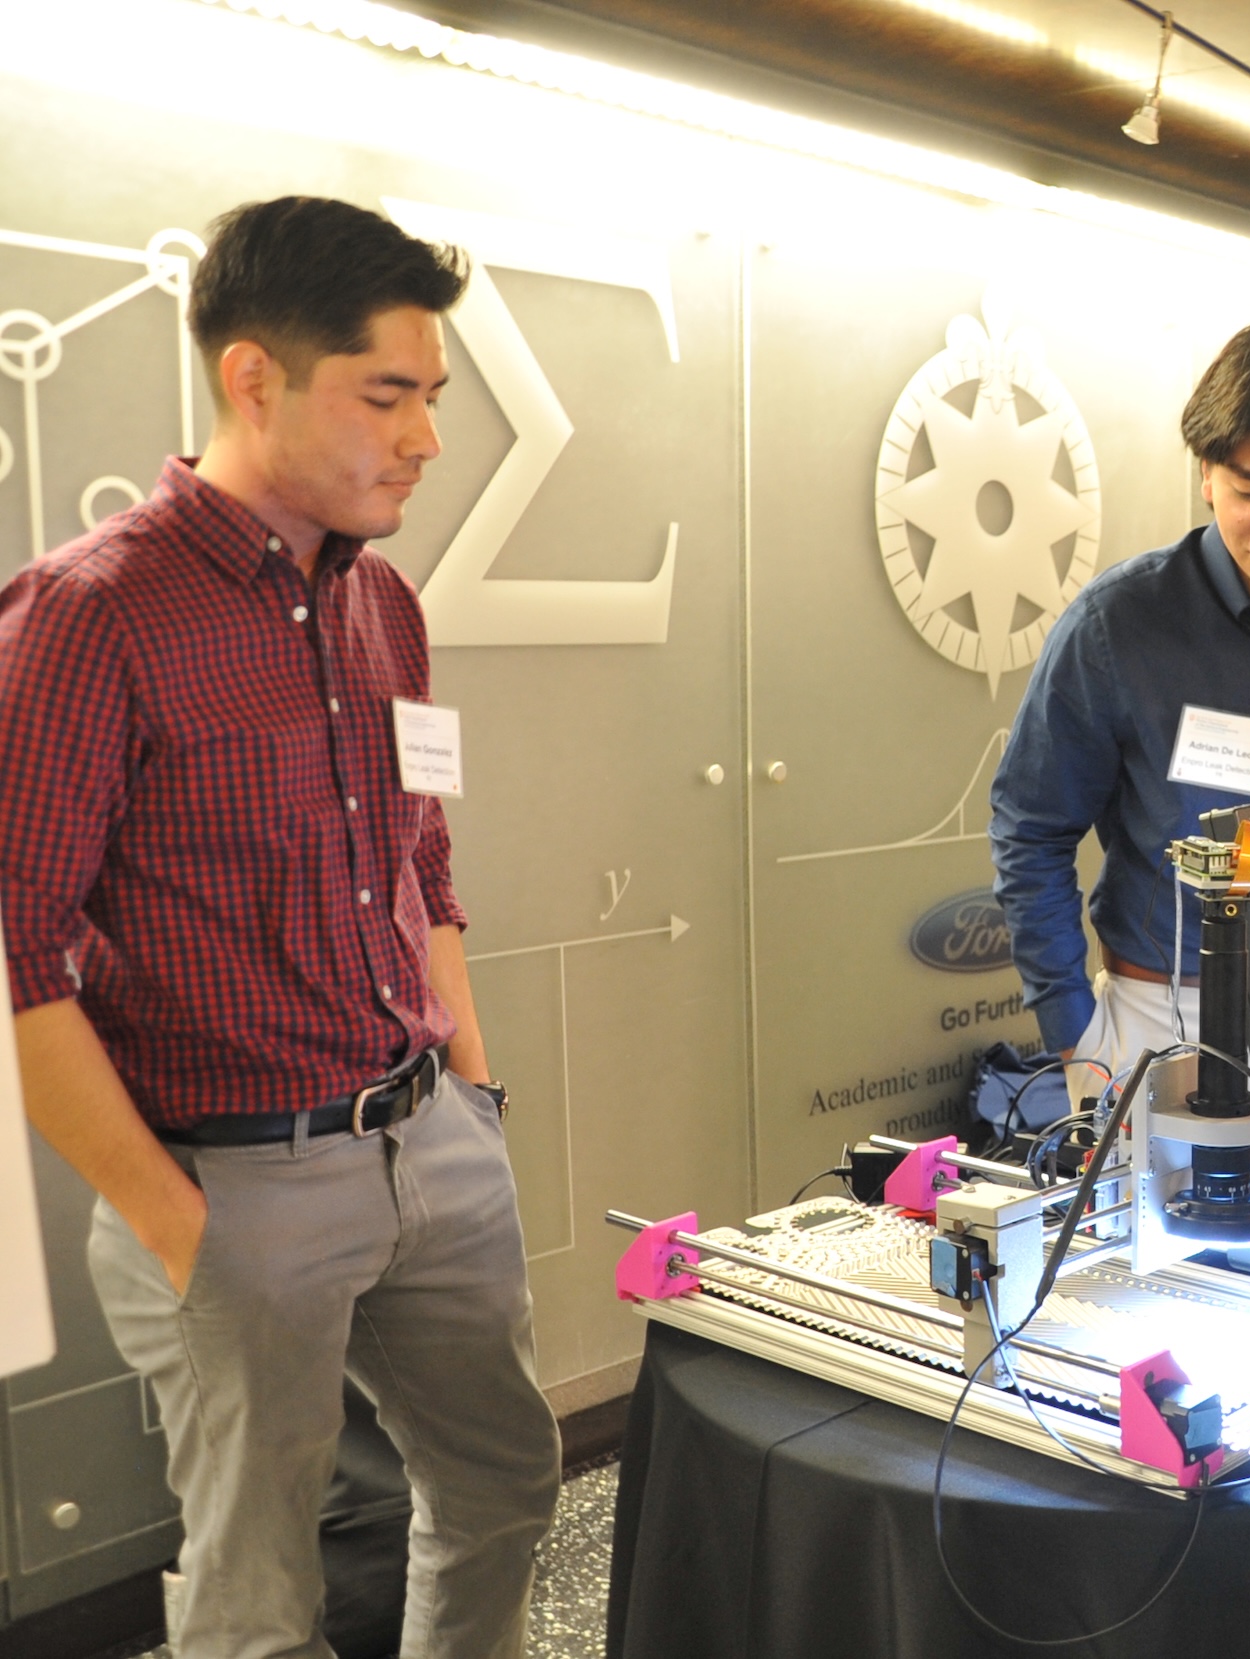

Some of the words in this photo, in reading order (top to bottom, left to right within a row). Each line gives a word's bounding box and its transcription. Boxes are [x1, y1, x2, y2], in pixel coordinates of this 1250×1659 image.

[1189, 741, 1220, 754] Adrian
[1221, 746, 1234, 756] De
[600, 868, 631, 921] y
[944, 902, 1010, 961] For
[940, 1006, 970, 1031] Go
[975, 992, 1026, 1024] Furth
[809, 1067, 918, 1117] Academic
[926, 1054, 964, 1086] and
